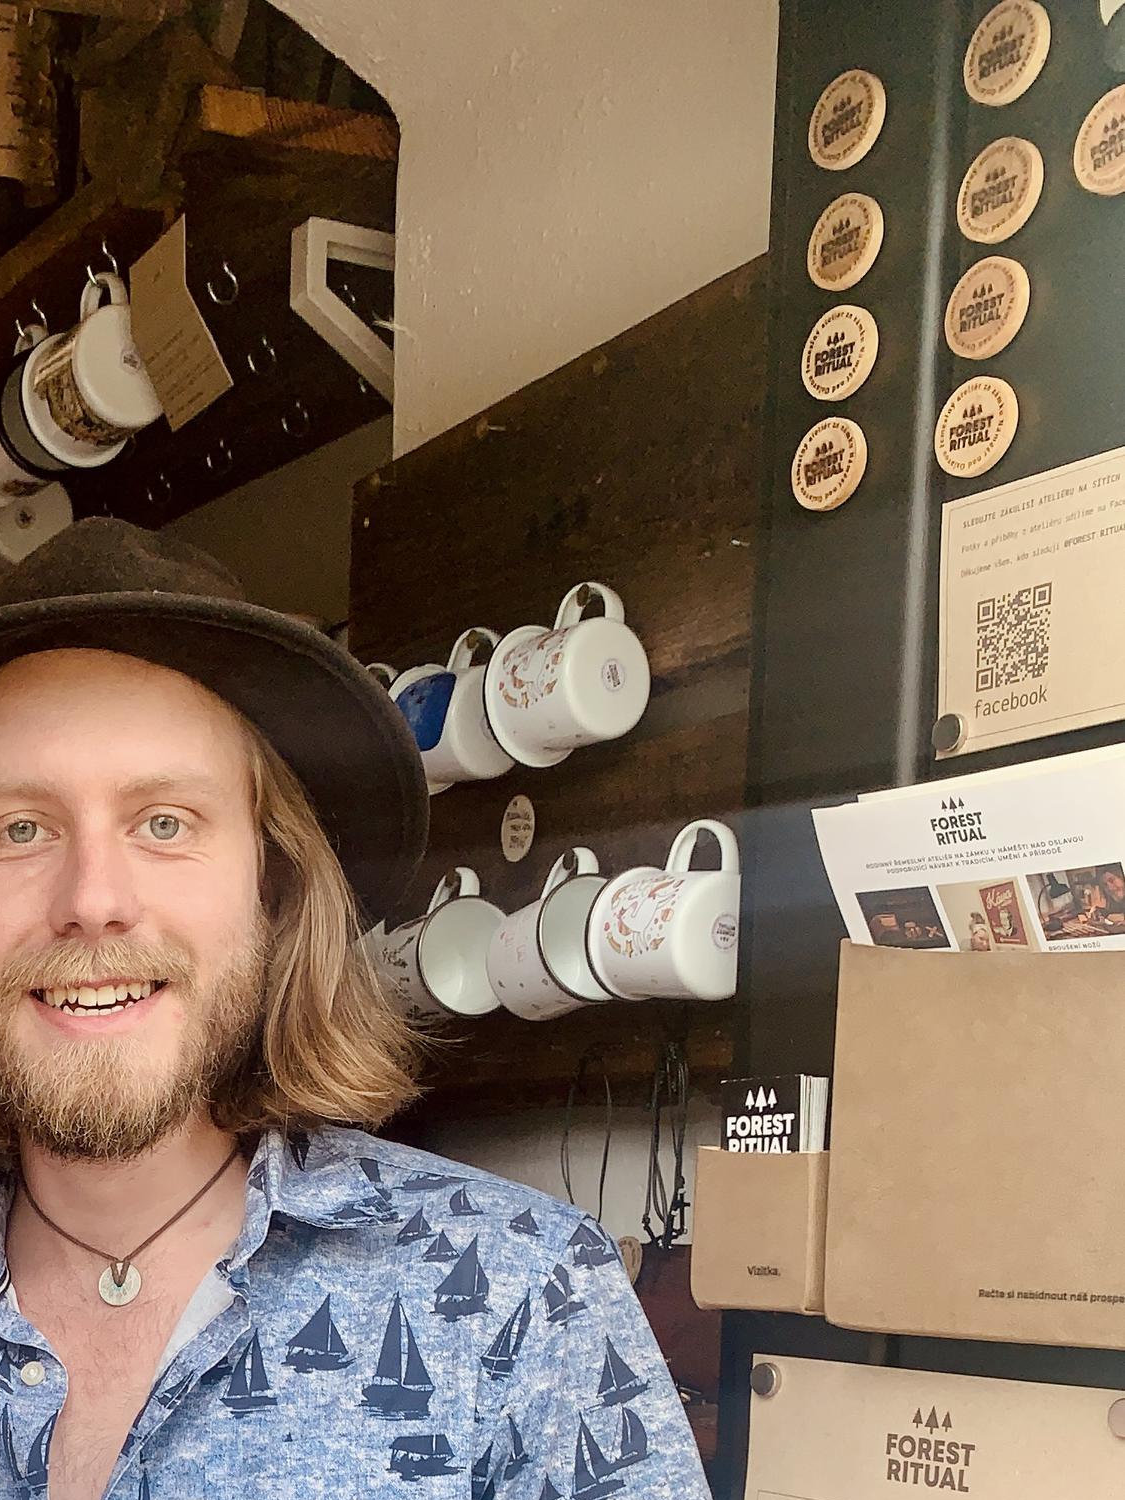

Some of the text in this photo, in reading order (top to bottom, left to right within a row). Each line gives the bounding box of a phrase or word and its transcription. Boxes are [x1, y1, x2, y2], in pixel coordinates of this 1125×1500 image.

[959, 293, 1005, 320] FOREST
[960, 308, 1001, 332] RITUAL
[815, 341, 855, 363] FOREST
[815, 356, 852, 377] RITUAL
[949, 415, 994, 439] FOREST
[949, 430, 990, 452] RITUAL
[963, 512, 995, 528] SLEDUJTE
[1079, 484, 1087, 492] NA
[974, 684, 1048, 719] facebook
[930, 811, 983, 832] FOREST
[936, 827, 986, 846] RITUAL
[1031, 841, 1046, 849] NAD
[1048, 835, 1084, 846] OSLAVOU
[726, 1113, 795, 1138] FOREST
[728, 1136, 792, 1154] RITUAL
[886, 1433, 975, 1466] FOREST
[887, 1458, 969, 1492] RITUAL
